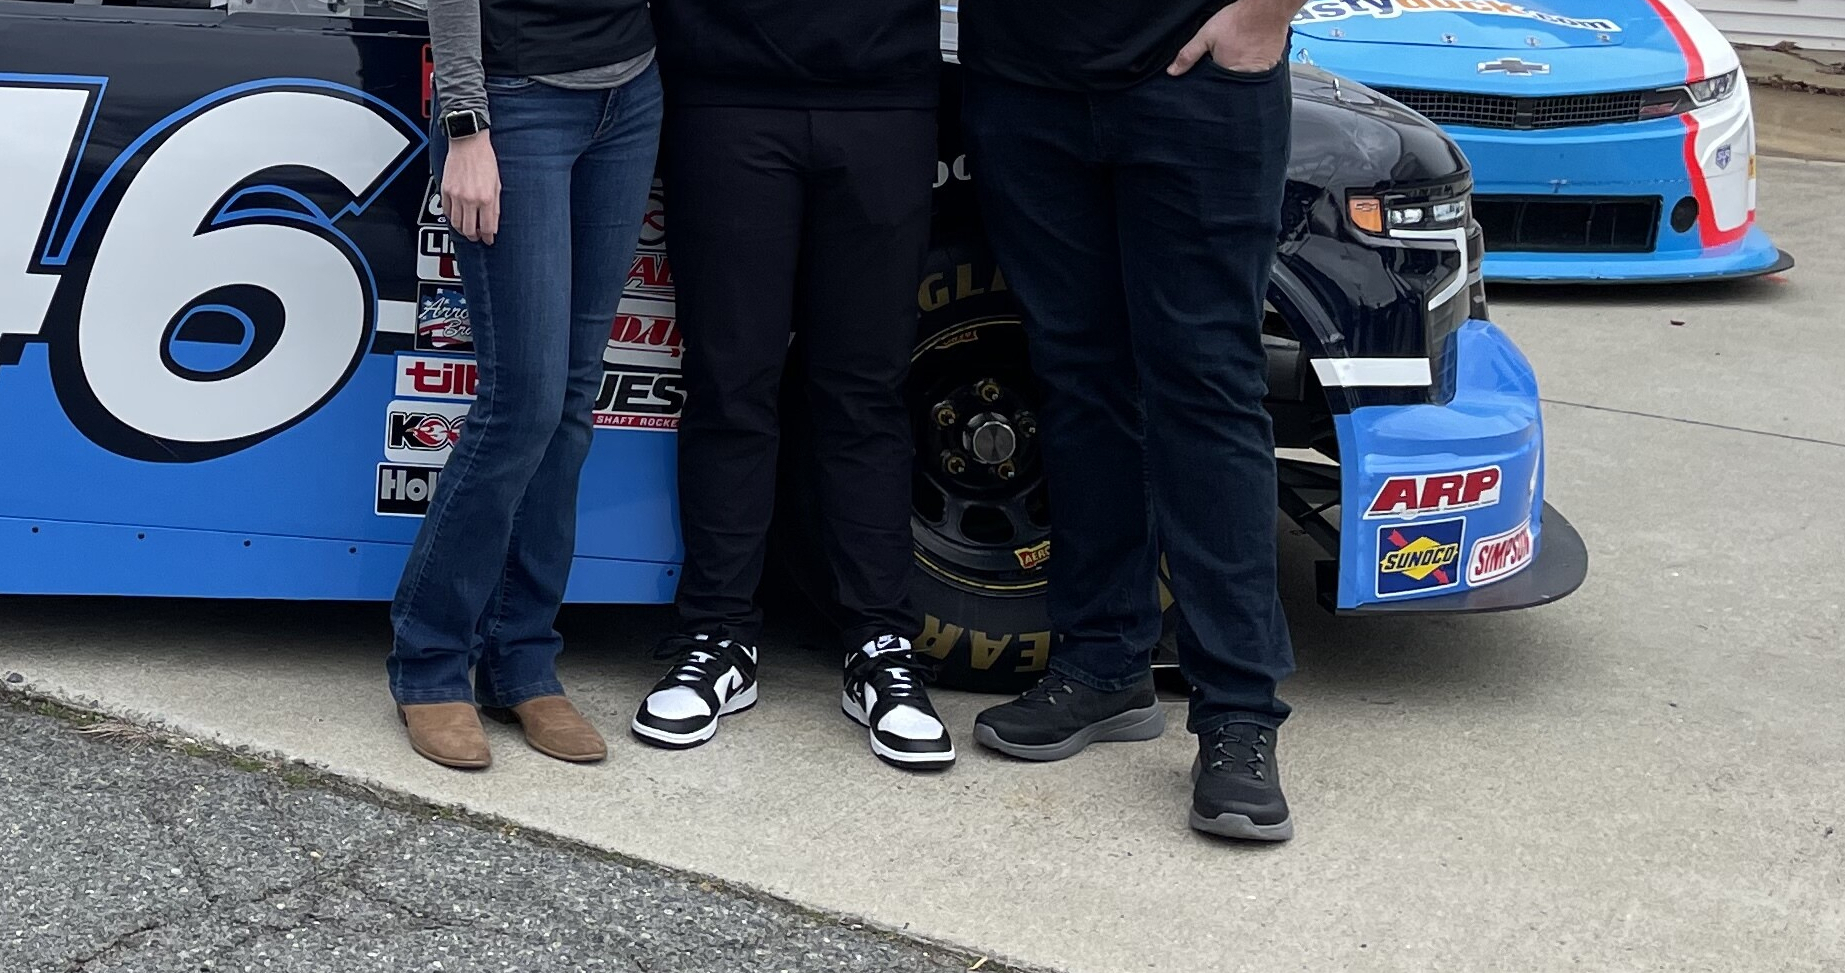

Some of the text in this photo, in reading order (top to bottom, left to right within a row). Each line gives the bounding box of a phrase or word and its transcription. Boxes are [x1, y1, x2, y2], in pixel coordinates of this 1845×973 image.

[406, 361, 480, 395] tilt
[593, 374, 685, 415] JES
[596, 415, 680, 428] SHAFT ROCKE
[381, 469, 442, 502] Hol
[1369, 467, 1500, 512] ARP
[1384, 545, 1456, 571] SUNOCO
[1474, 530, 1531, 577] SIMPSON
